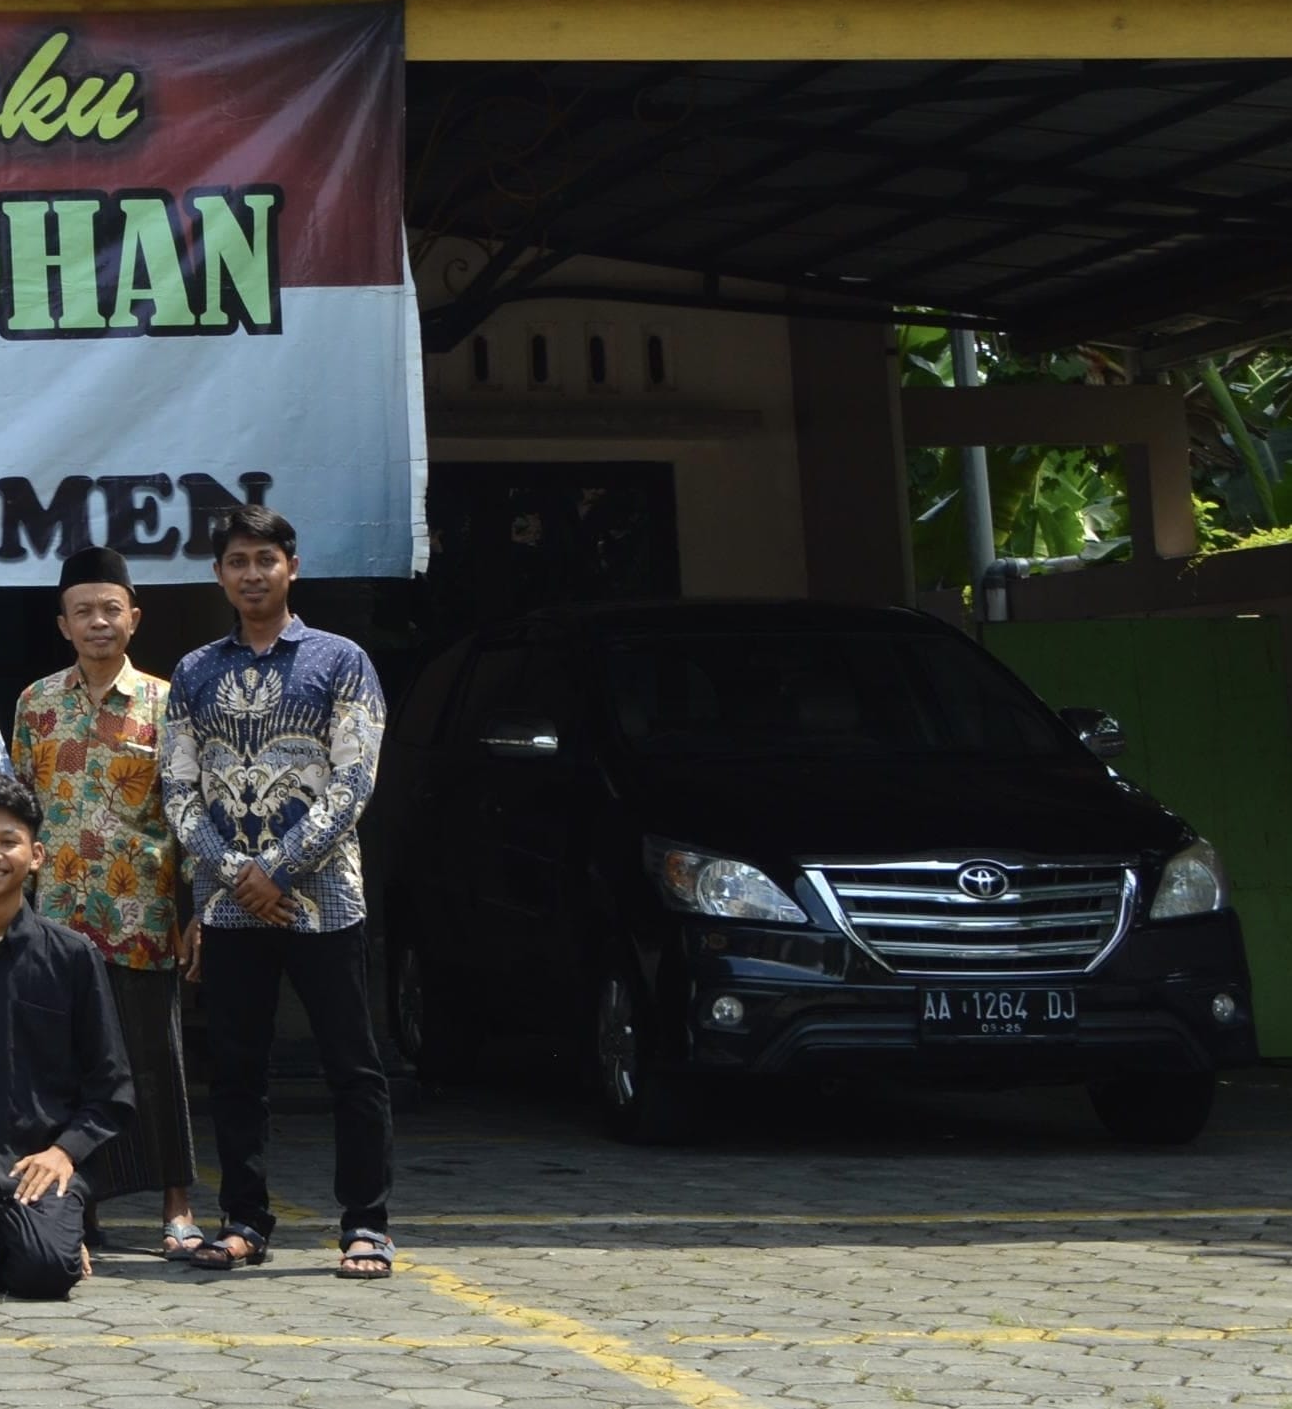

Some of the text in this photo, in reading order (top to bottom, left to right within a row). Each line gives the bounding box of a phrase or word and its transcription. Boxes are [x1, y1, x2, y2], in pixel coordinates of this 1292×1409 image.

[923, 990, 1075, 1020] AA 1264 DJ
